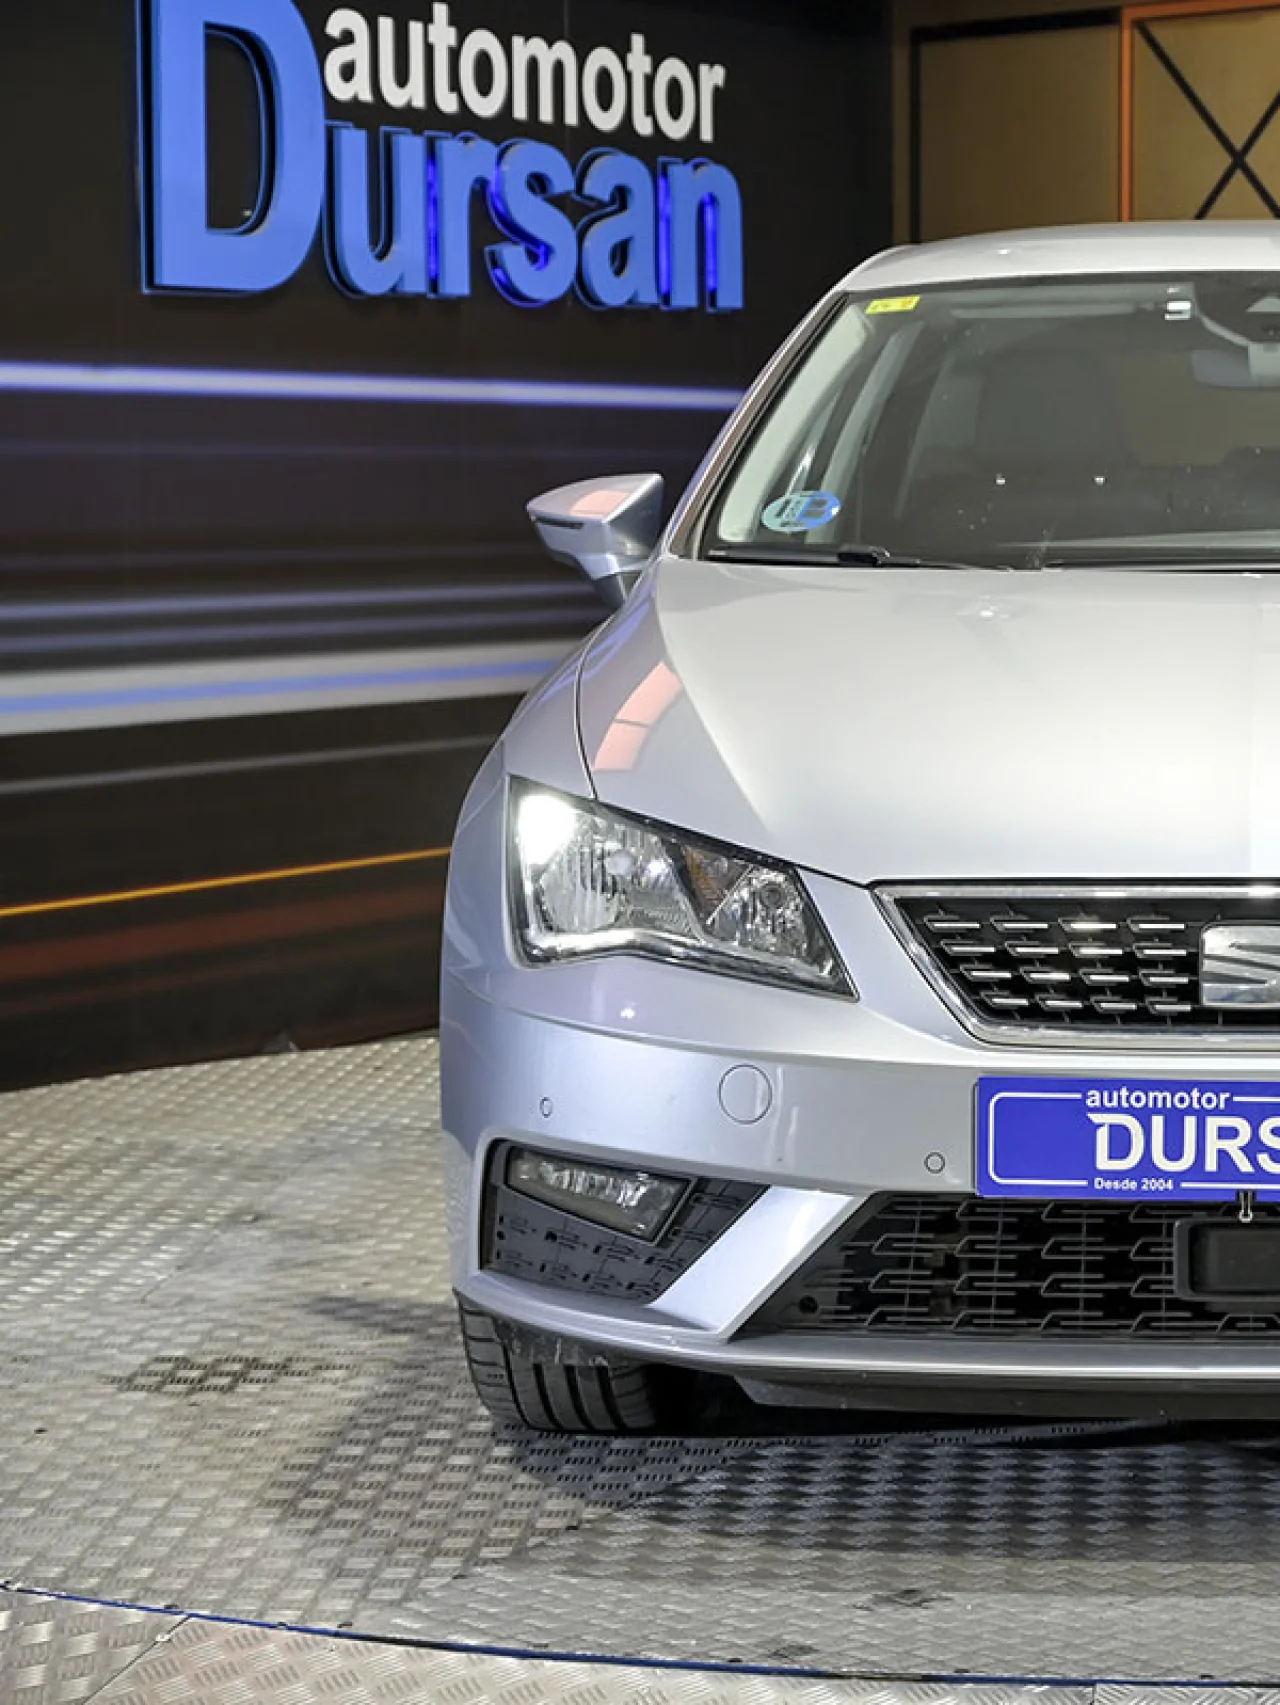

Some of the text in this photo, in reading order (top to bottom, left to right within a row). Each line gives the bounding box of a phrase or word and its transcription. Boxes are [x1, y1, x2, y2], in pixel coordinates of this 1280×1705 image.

[324, 1, 726, 142] automotor
[137, 0, 744, 311] Dursan
[1085, 1086, 1230, 1110] automotor
[1094, 1177, 1174, 1191] Desde 2004
